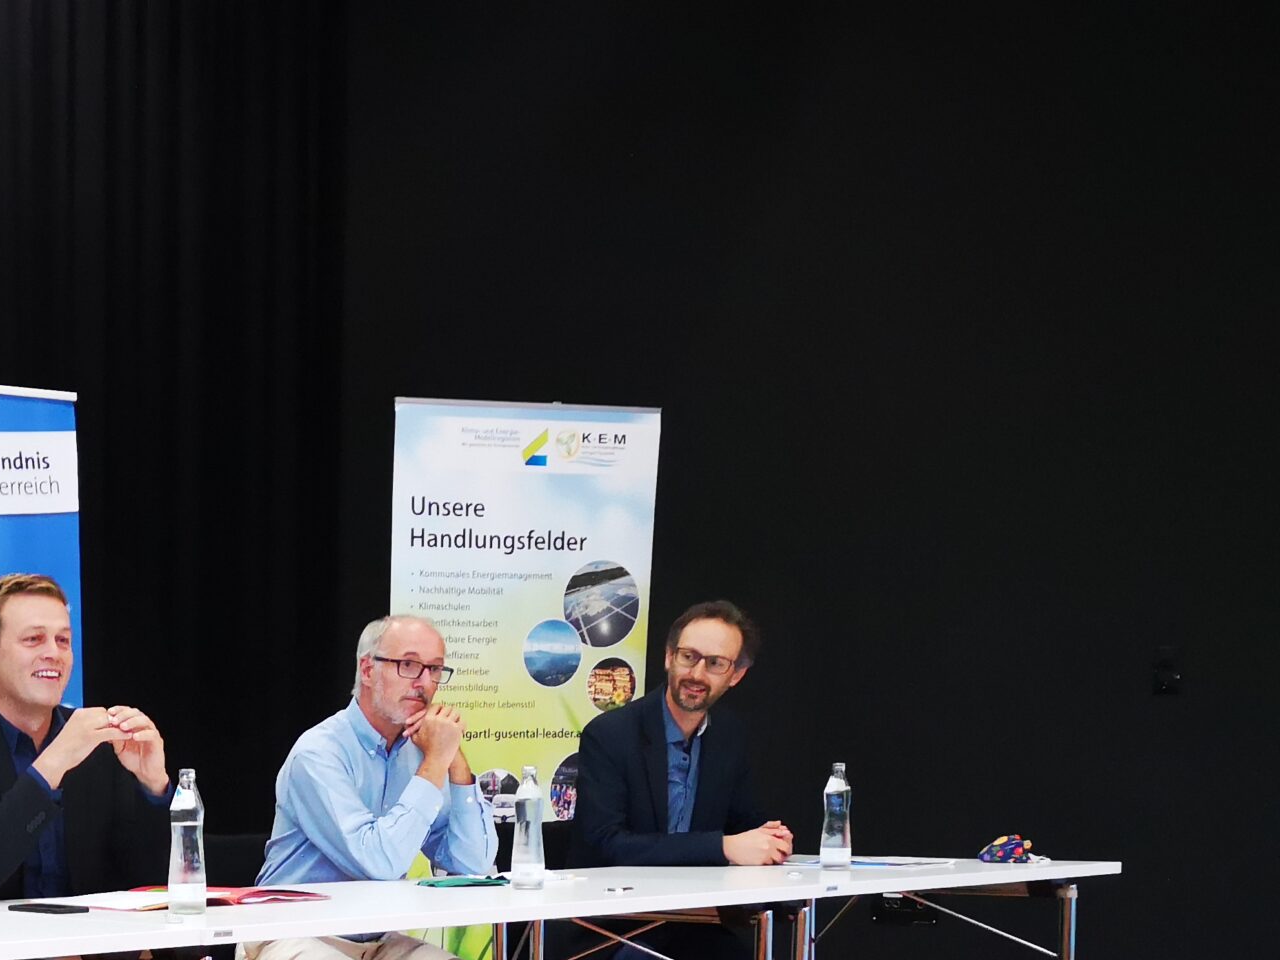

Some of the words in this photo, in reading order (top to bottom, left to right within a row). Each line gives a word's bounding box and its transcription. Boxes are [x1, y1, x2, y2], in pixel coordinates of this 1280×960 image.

[410, 495, 486, 518] Unsere
[410, 527, 588, 555] Handlungsfelder
[419, 569, 470, 579] Kommunales
[419, 586, 466, 597] Nachhaltige
[418, 602, 471, 612] Klimaschulen
[467, 635, 498, 646] Energie
[444, 651, 480, 661] effizienz
[456, 666, 491, 677] Betriebe
[497, 700, 536, 710] Lebensstil
